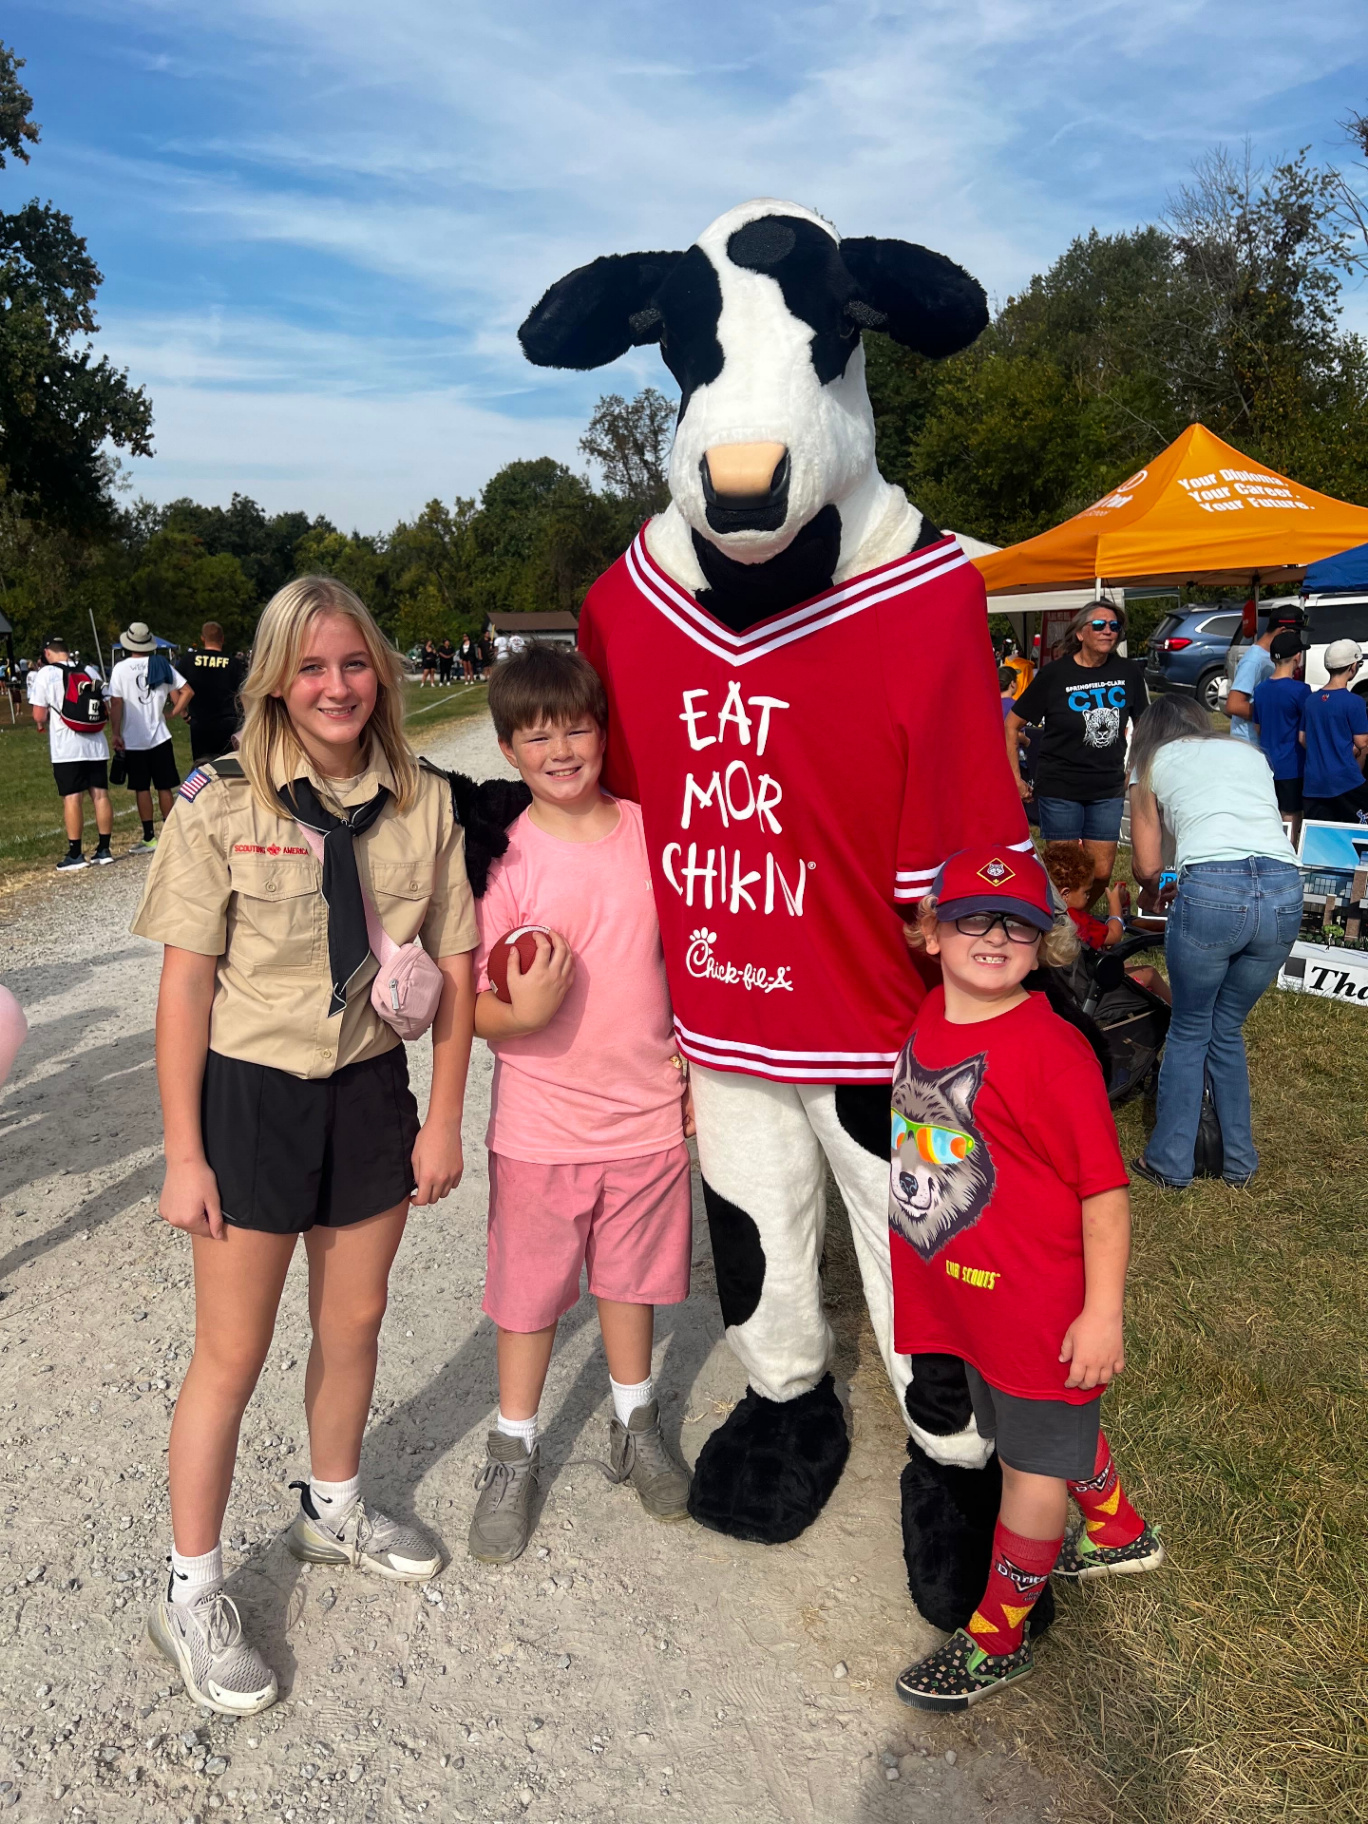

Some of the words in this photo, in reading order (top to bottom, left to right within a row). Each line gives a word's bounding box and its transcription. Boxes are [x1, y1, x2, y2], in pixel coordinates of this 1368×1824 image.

[1177, 473, 1217, 490] Your
[1219, 468, 1289, 487] Diploma.
[1187, 486, 1231, 503] Your
[1199, 499, 1245, 512] Your
[1246, 497, 1316, 510] Future.
[194, 655, 229, 668] STAFF
[1065, 680, 1126, 693] SPRINGFIELD-CLARK
[1068, 686, 1127, 712] CTC
[679, 680, 790, 756] EAT
[681, 760, 782, 834] MOR
[234, 844, 266, 854] SCOUTING
[283, 846, 309, 855] AMERICA
[685, 928, 794, 993] Chick-fil-A
[946, 1259, 960, 1280] CUB
